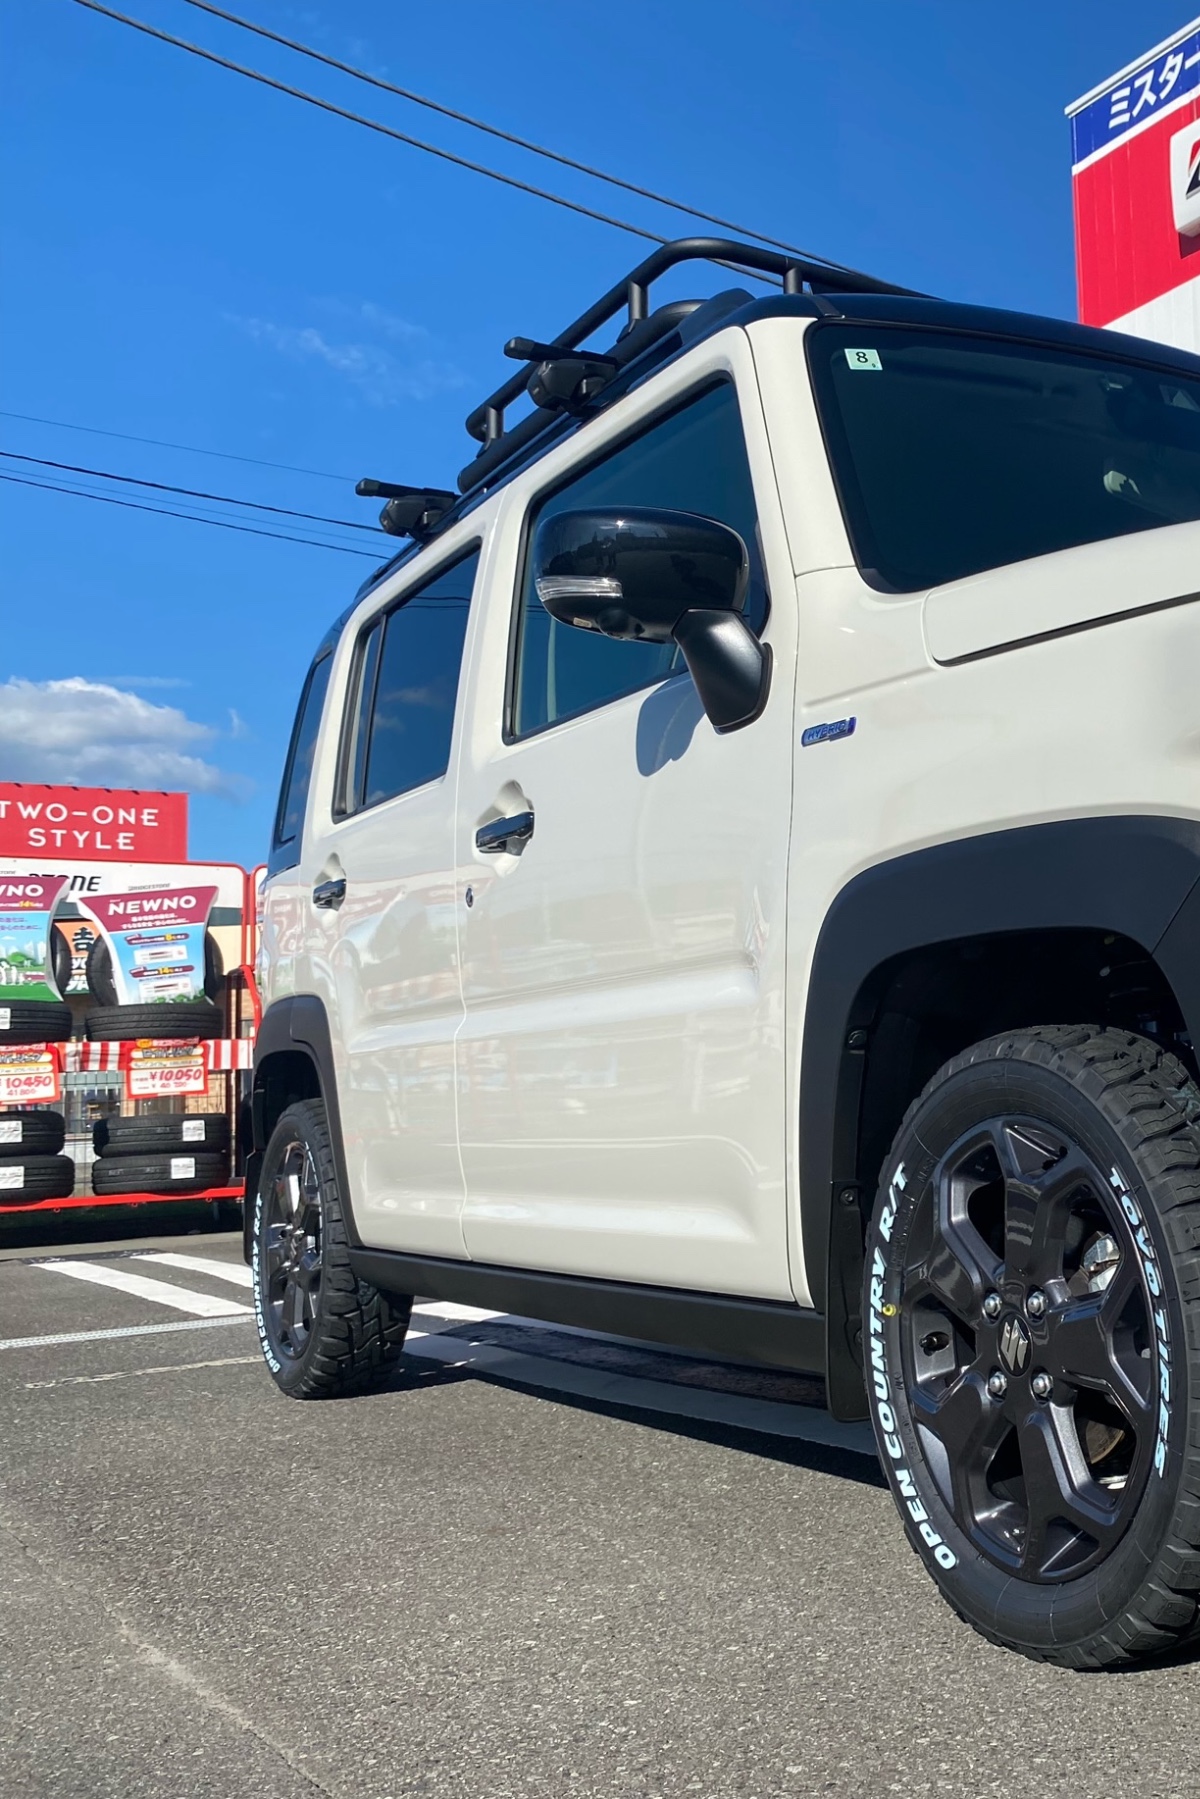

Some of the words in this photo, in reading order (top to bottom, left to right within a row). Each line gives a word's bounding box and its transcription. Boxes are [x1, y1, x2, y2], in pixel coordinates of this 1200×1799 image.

[856, 352, 868, 363] 8
[0, 801, 159, 827] TWO-ONE
[28, 828, 135, 850] STYLE
[108, 895, 197, 916] NEWNO
[880, 1161, 909, 1243] R/T
[1108, 1166, 1160, 1297] TOYO
[1153, 1308, 1172, 1479] TIRES
[869, 1247, 902, 1459] COUNTRY
[900, 1470, 958, 1570] OPEN
